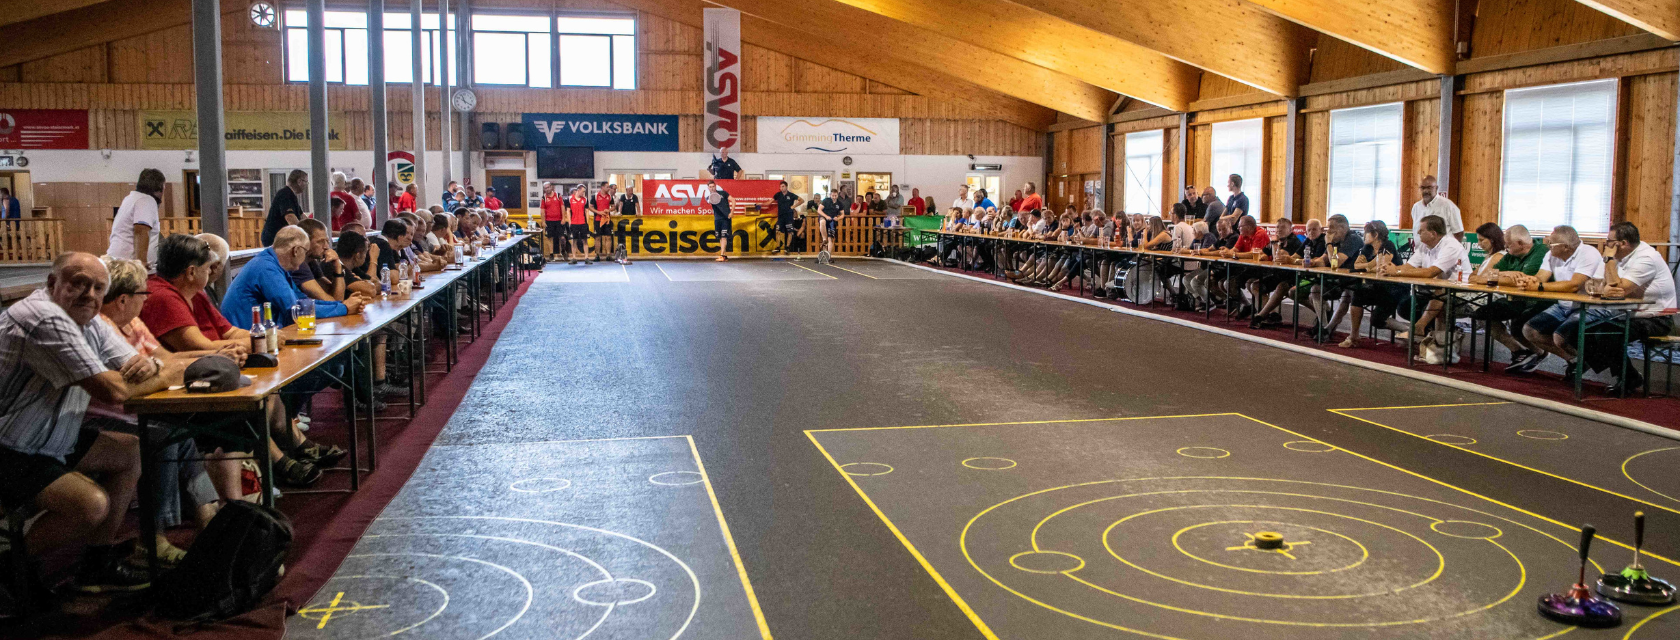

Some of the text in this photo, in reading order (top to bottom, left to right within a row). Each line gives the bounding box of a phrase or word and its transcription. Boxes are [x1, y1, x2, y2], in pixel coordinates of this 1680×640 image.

[568, 121, 669, 135] VOLKSBANK
[224, 129, 304, 140] aiffeisen.Die
[784, 132, 871, 143] GrimmingTherme
[651, 184, 723, 206] ASV
[698, 207, 714, 215] Spo
